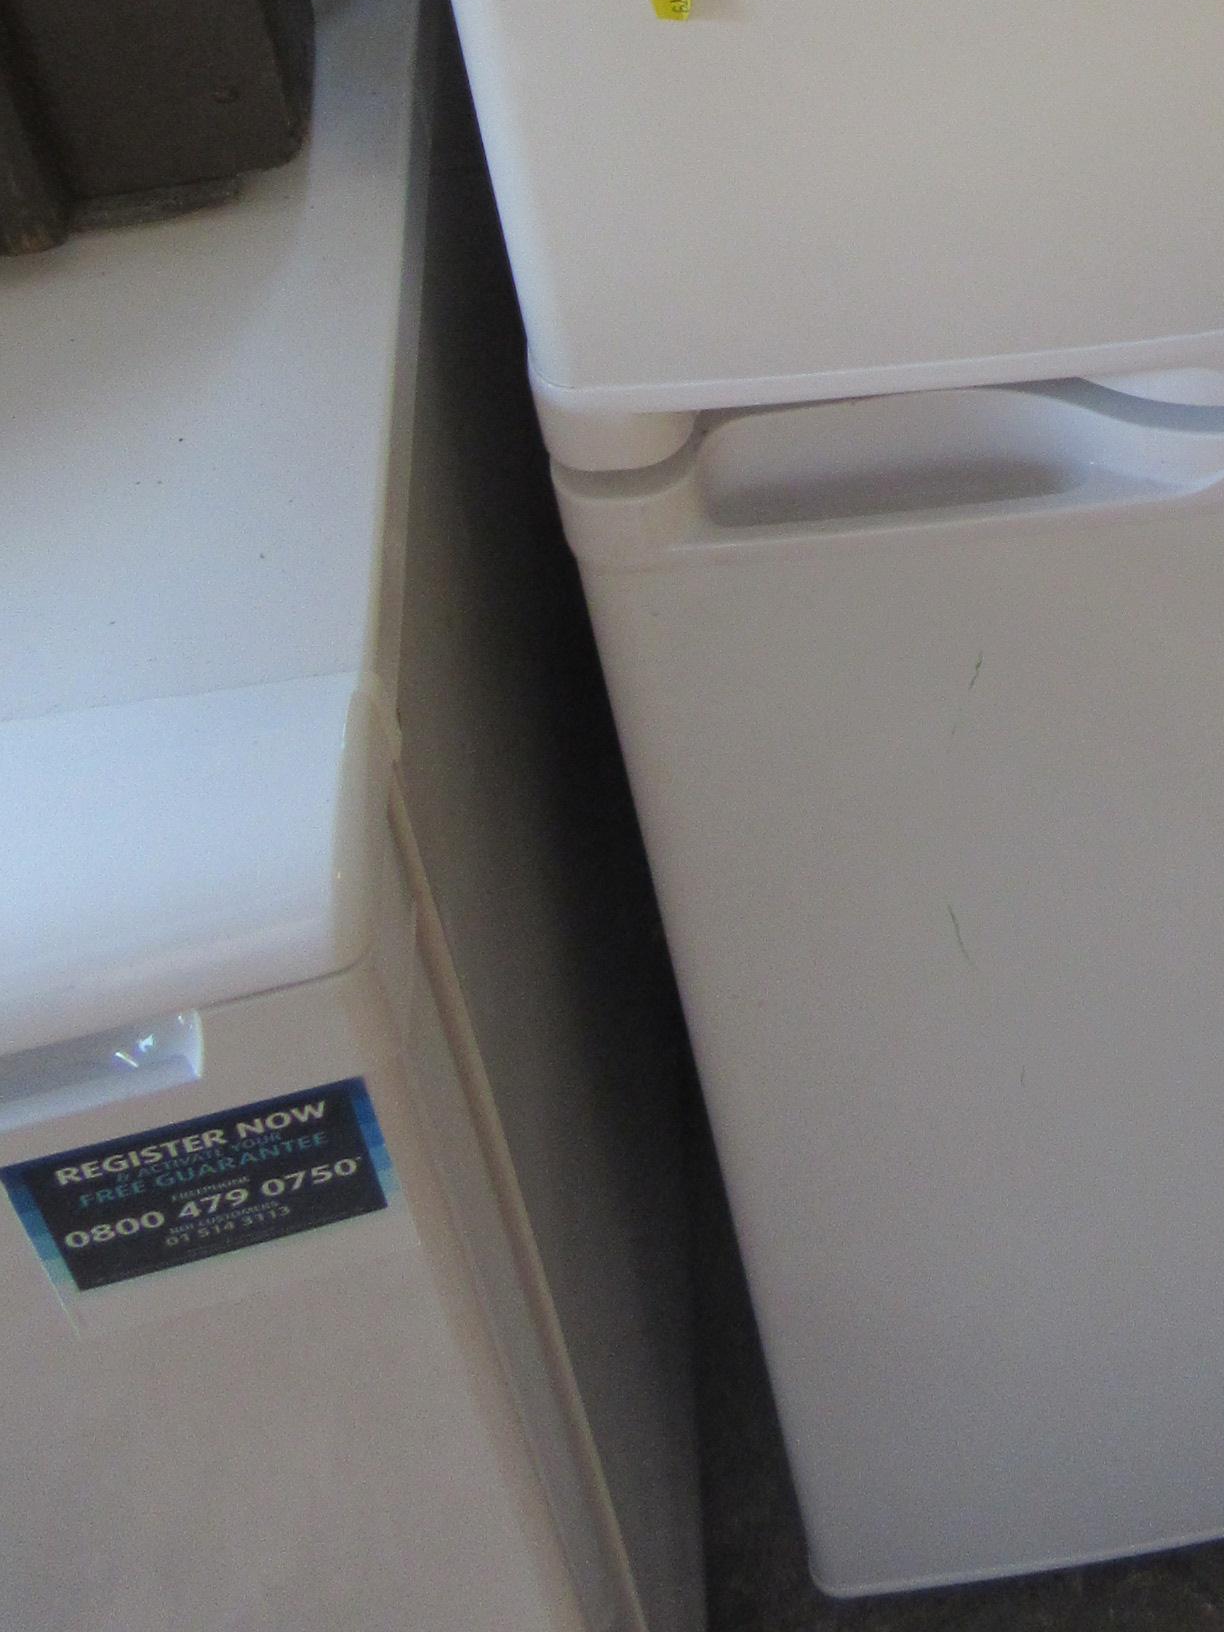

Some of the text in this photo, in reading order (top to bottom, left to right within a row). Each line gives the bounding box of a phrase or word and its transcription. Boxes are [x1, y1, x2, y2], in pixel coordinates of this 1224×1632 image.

[55, 1100, 326, 1186] REGISTER NOW
[79, 1131, 328, 1208] FREE GUARANTEE
[230, 1131, 282, 1153] YOUR
[64, 1211, 165, 1248] 0800
[178, 1188, 249, 1219] 479
[166, 1233, 190, 1247] 01
[198, 1221, 235, 1238] 514
